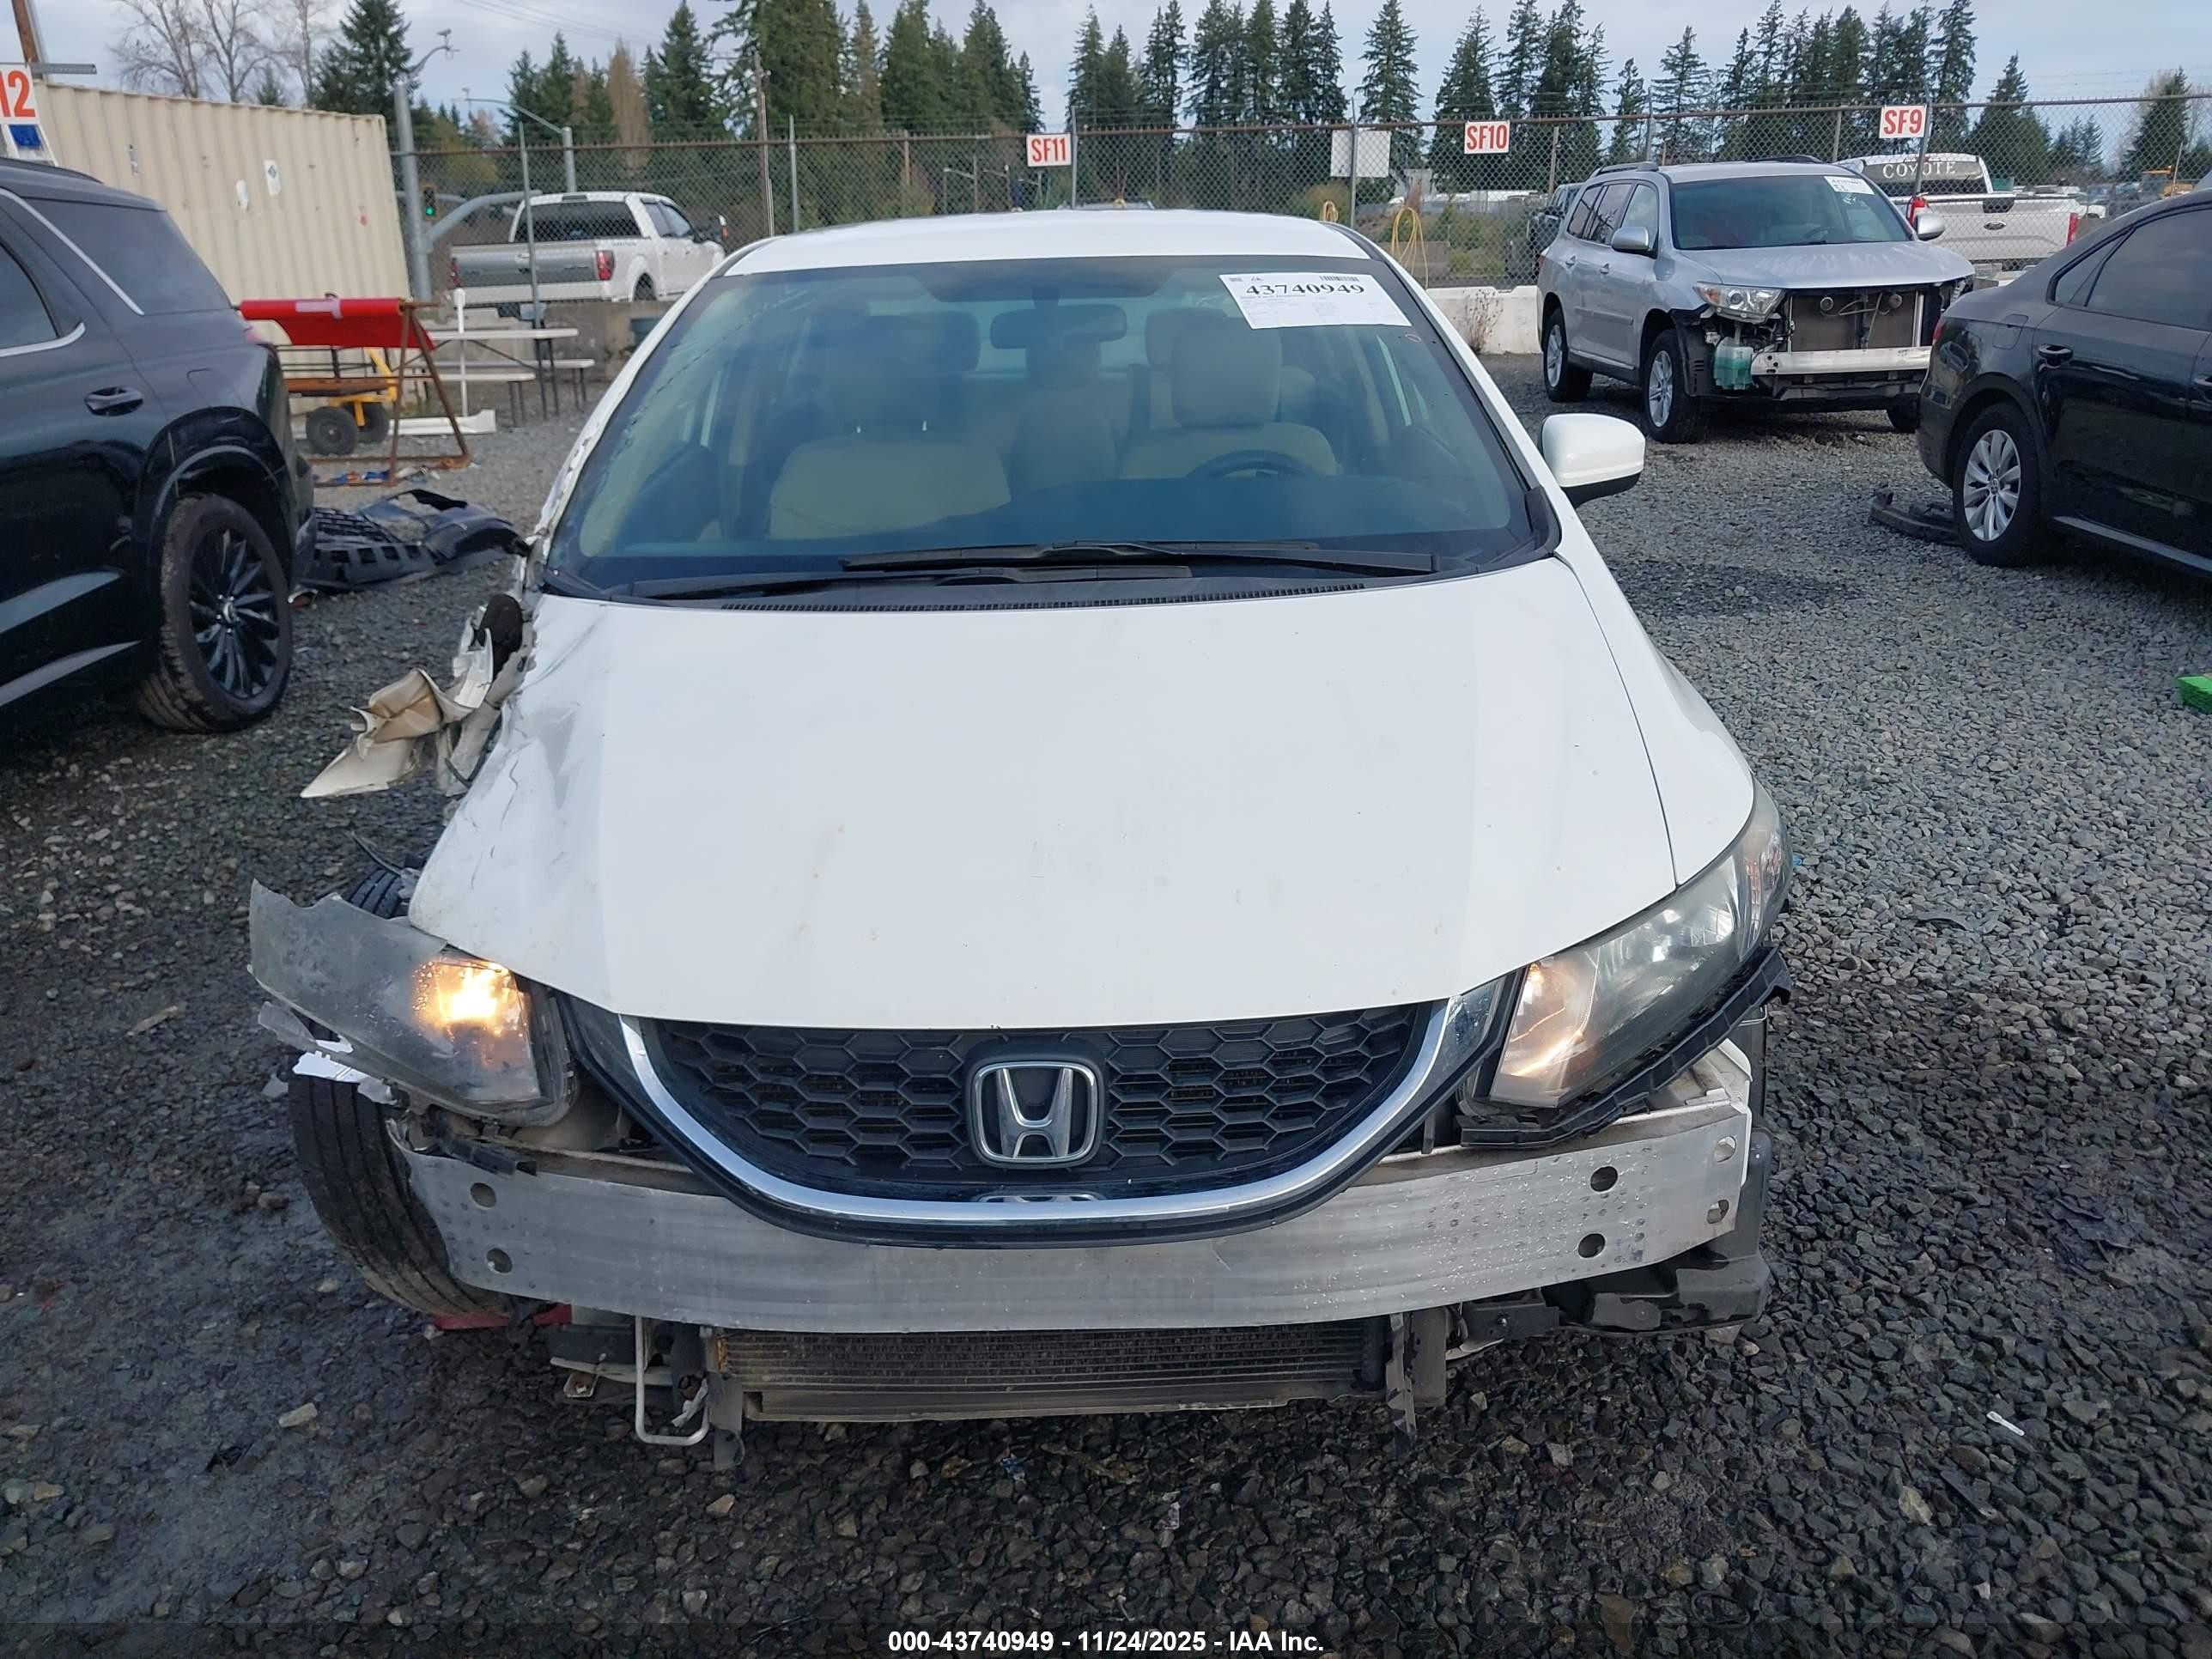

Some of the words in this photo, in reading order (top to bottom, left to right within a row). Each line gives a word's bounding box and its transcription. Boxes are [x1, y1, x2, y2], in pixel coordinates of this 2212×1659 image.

[1883, 109, 1923, 135] SF9
[1467, 125, 1508, 149] SF10
[1031, 137, 1066, 162] SF11
[1882, 161, 1956, 179] COYOTE
[1246, 283, 1365, 295] 43740949
